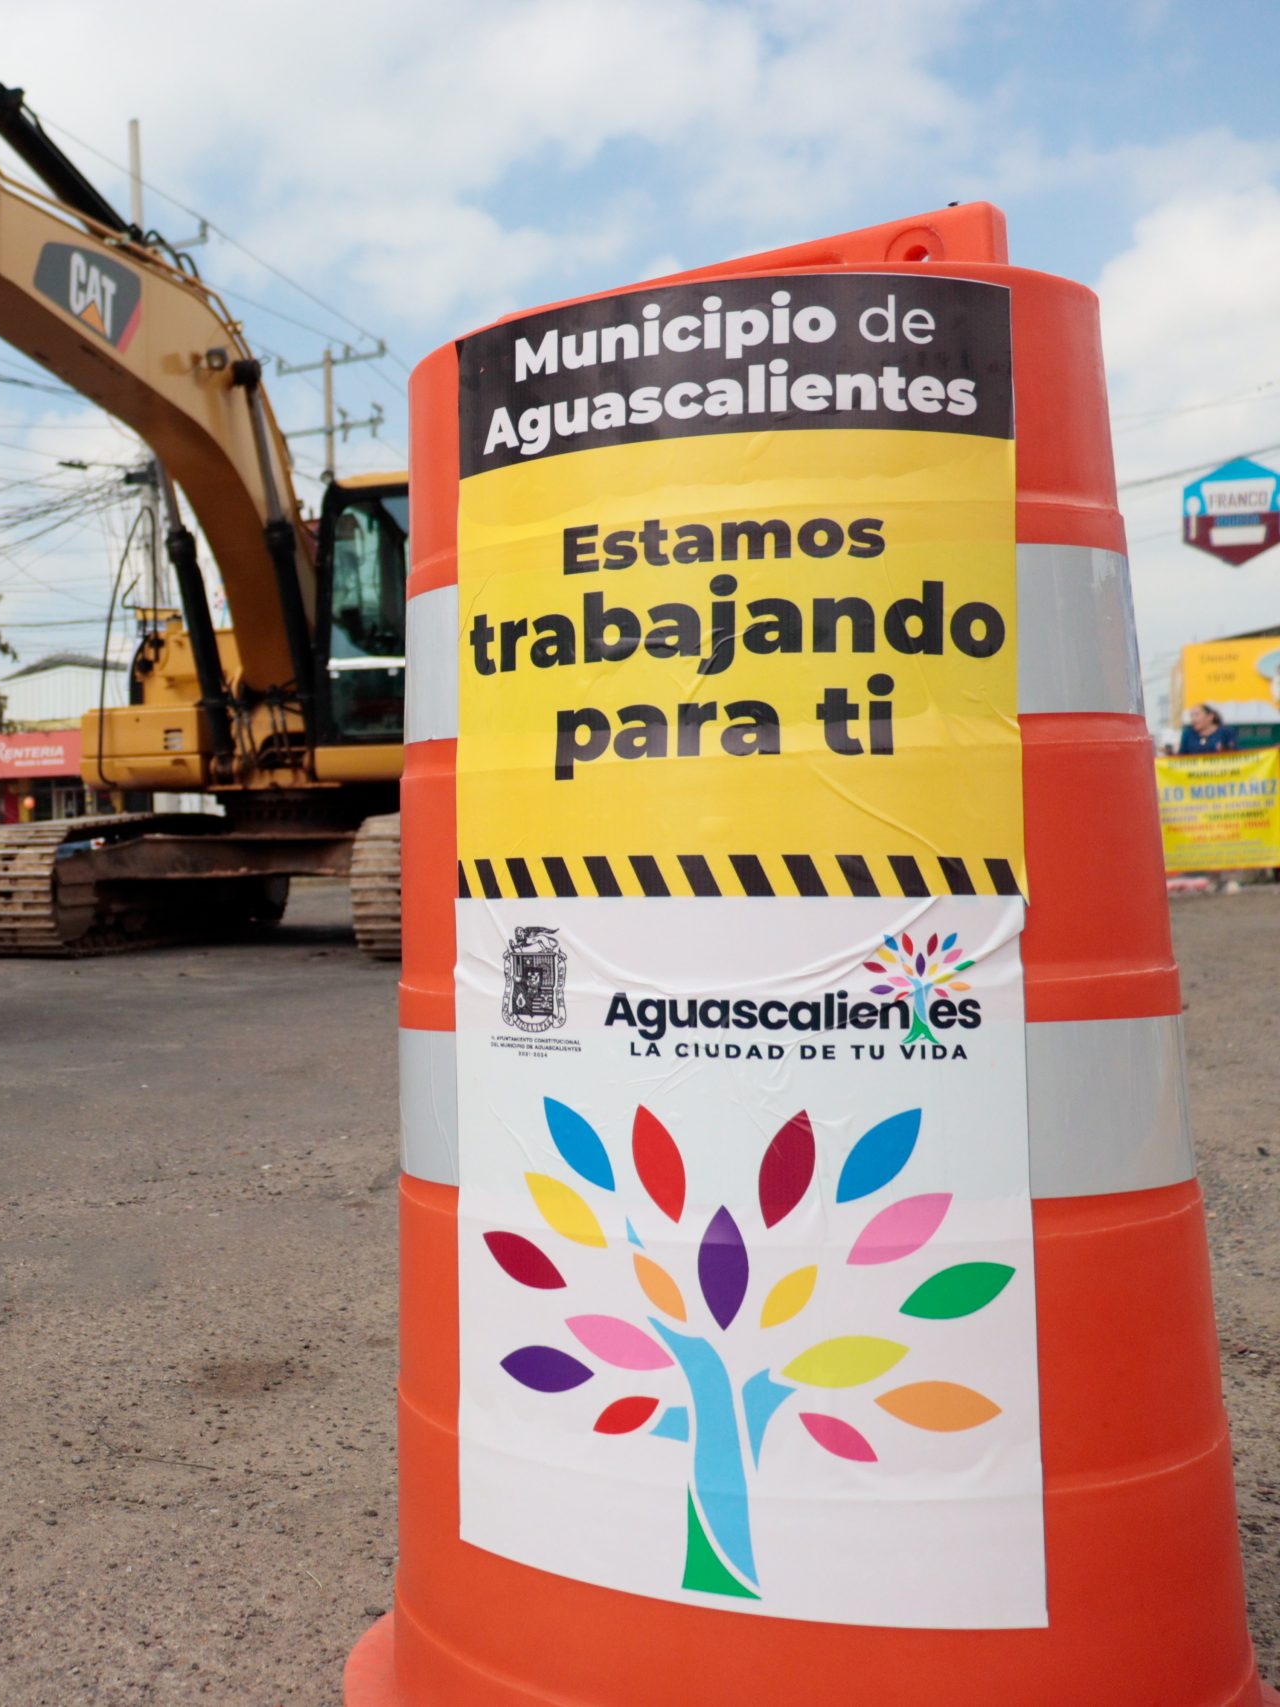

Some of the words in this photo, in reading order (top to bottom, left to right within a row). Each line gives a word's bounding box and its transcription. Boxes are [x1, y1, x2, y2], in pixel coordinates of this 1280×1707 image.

[70, 251, 117, 340] CAT
[514, 291, 837, 382] Municipio
[858, 294, 936, 344] de
[483, 359, 977, 455] Aguascalientes
[1209, 491, 1268, 509] FRANCO
[563, 517, 885, 575] Estamos
[470, 574, 1006, 677] trabajando
[555, 700, 781, 780] para
[816, 673, 894, 756] ti
[1190, 777, 1277, 800] MONTAÑEZ
[604, 988, 981, 1044] Aguascalientes
[630, 1041, 661, 1058] LA
[675, 1042, 784, 1060] CIUDAD
[801, 1043, 836, 1060] DE
[853, 1044, 886, 1061] TU
[903, 1044, 968, 1060] VIDA
